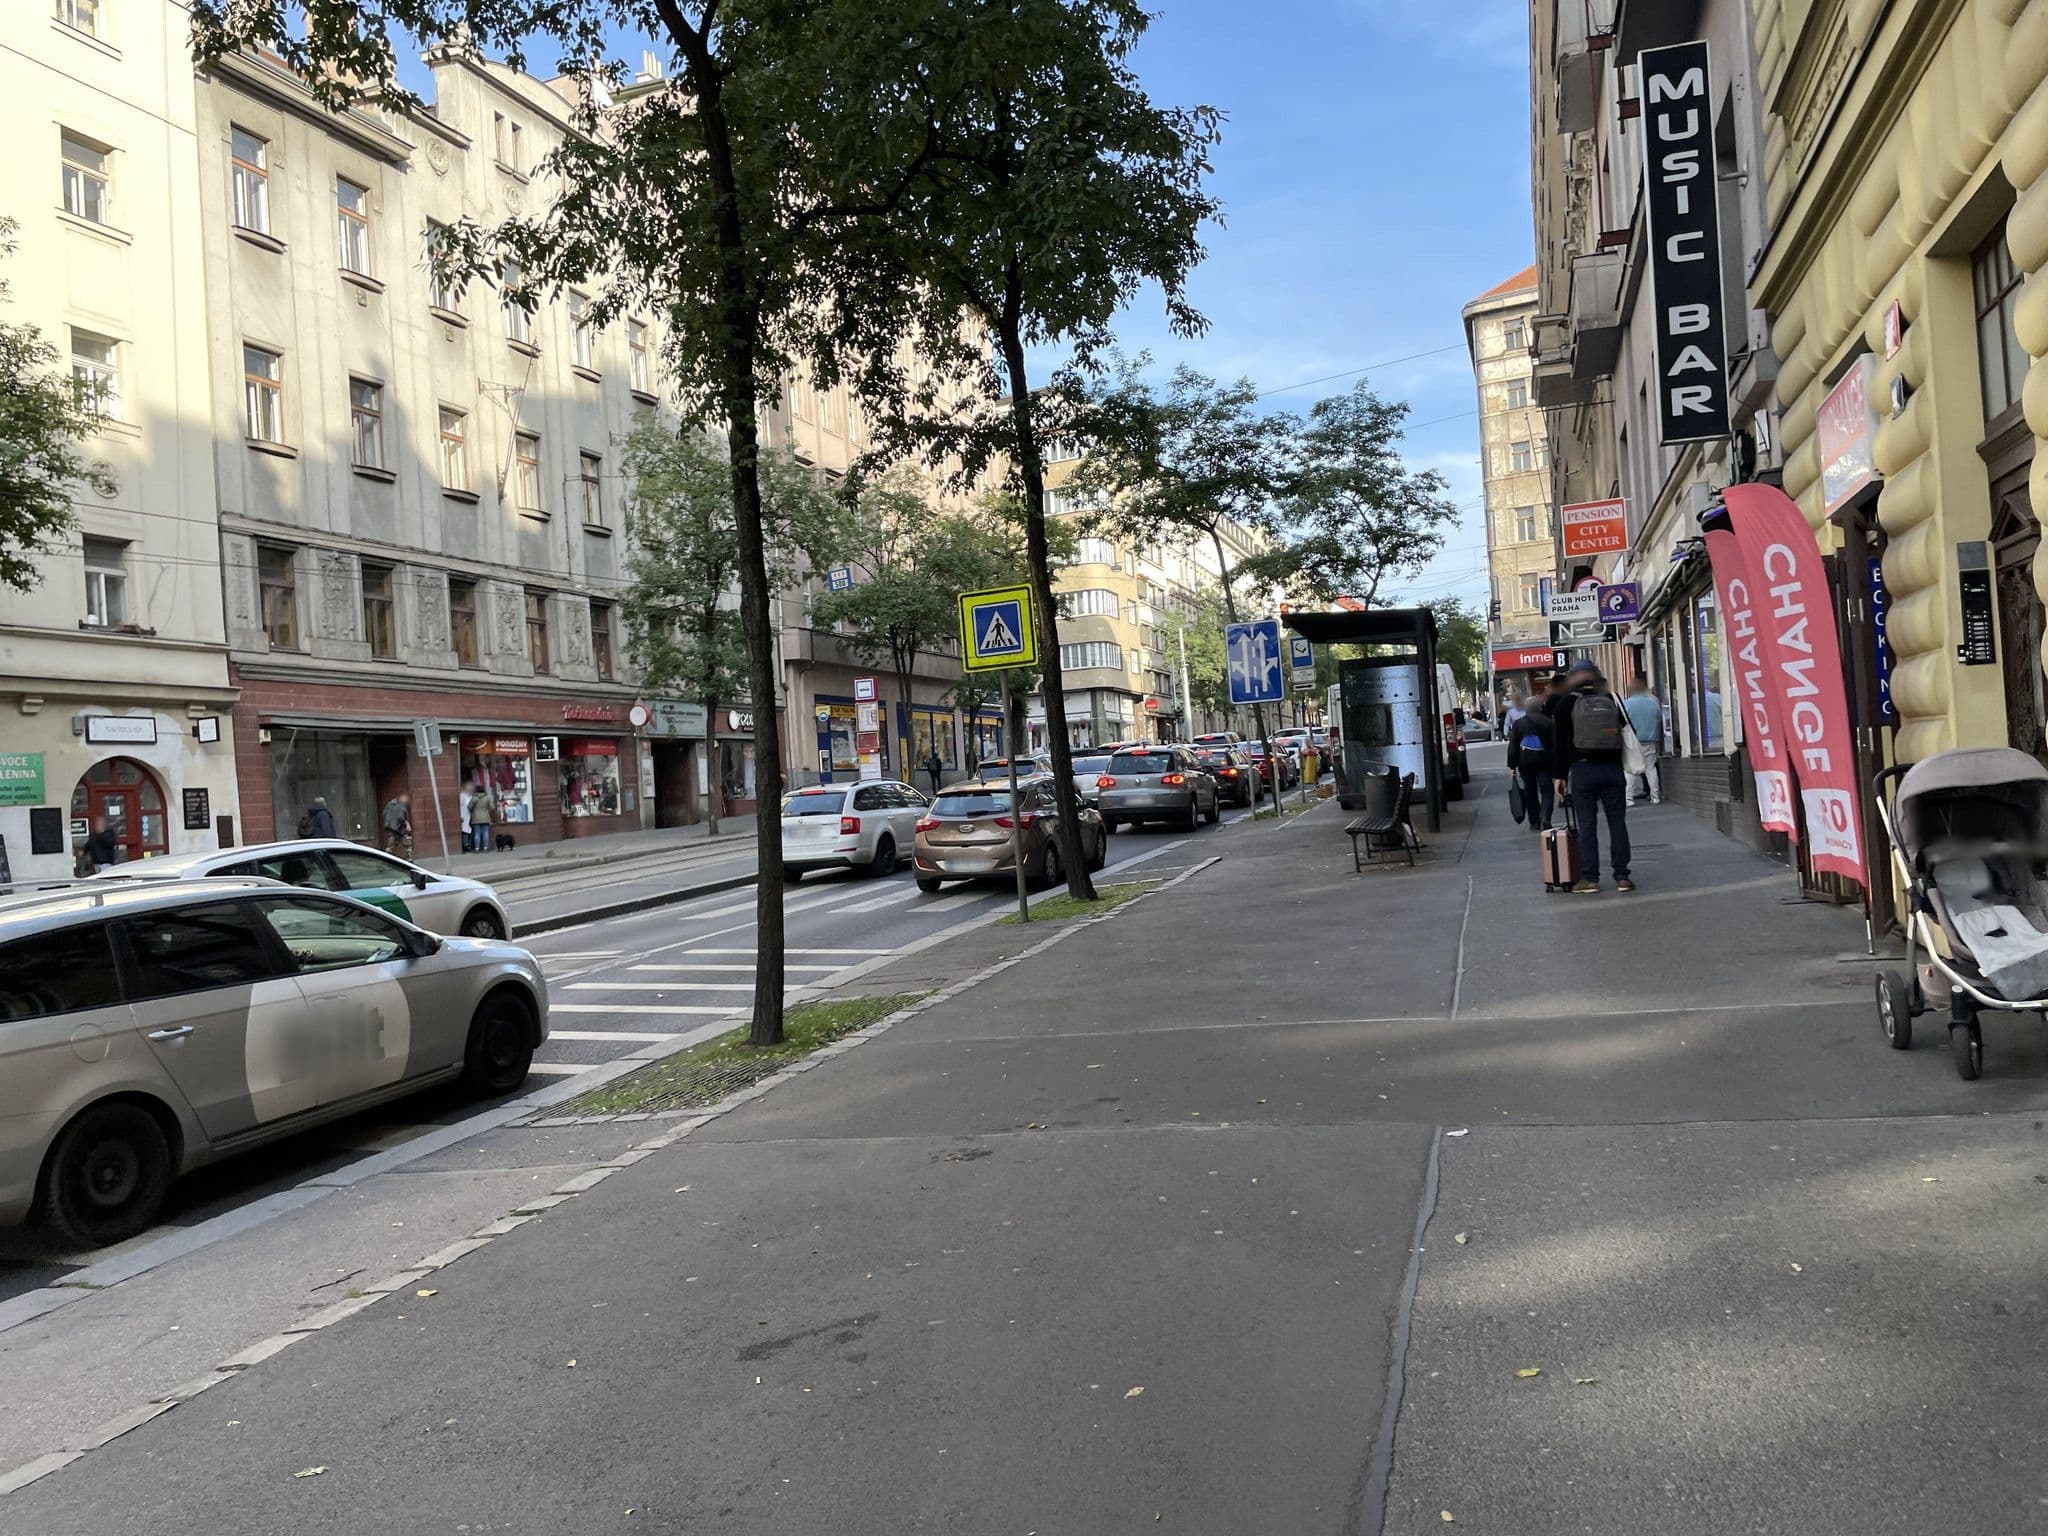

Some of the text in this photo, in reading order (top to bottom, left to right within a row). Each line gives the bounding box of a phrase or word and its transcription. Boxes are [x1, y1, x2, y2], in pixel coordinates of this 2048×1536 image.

[1649, 67, 1718, 416] MUSIC BAR
[1567, 506, 1620, 521] PENSION
[1580, 524, 1608, 536] CITY
[1571, 535, 1620, 550] CENTER
[1551, 594, 1596, 605] CLUB HOTE
[1551, 604, 1580, 613] PRAHA
[1520, 653, 1553, 664] inme
[1557, 652, 1566, 668] B
[0, 756, 29, 767] VOCE
[0, 768, 37, 779] LENINA
